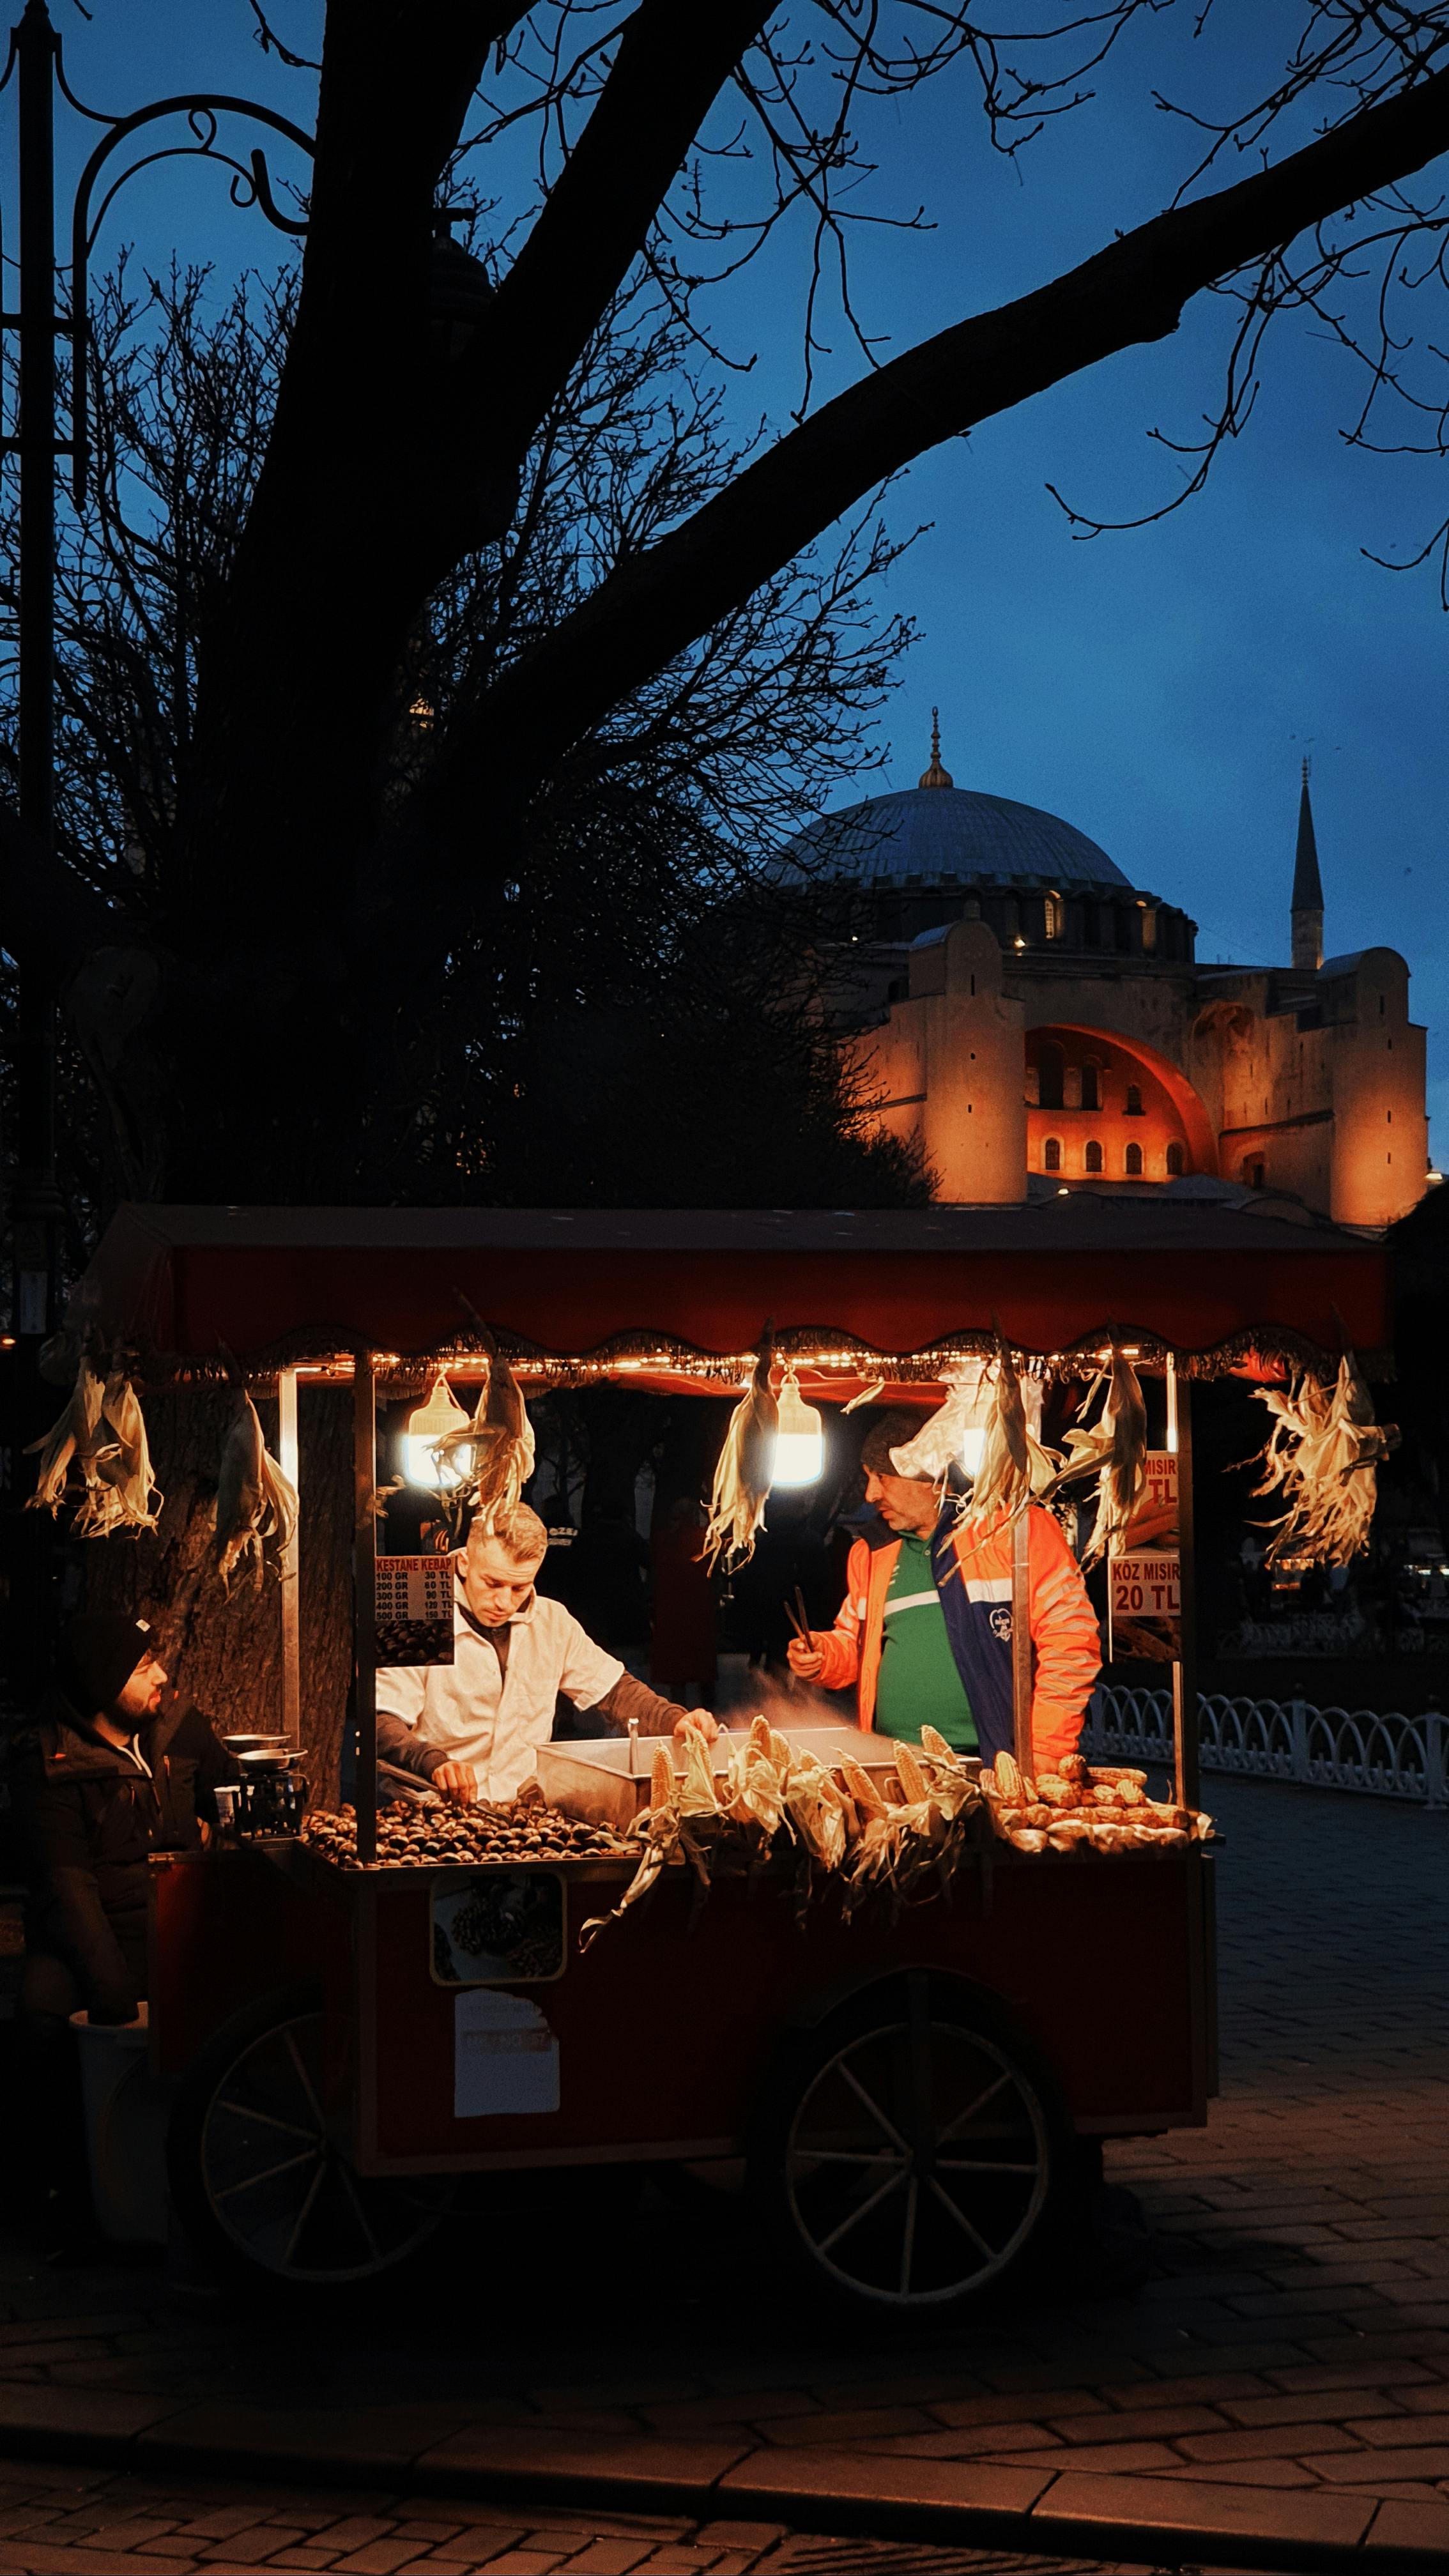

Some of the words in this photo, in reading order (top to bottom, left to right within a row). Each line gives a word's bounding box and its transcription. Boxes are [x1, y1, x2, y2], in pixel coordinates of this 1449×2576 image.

[1149, 1479, 1177, 1503] TL
[376, 1559, 418, 1571] KESTANE
[422, 1558, 451, 1570] KEBAP
[1113, 1560, 1139, 1580] KÖZ
[1144, 1563, 1181, 1579] MISIR
[425, 1571, 436, 1579] 30
[426, 1591, 436, 1599] 90
[1116, 1585, 1143, 1610] 20
[1151, 1585, 1179, 1609] TL
[376, 1602, 393, 1610] 400
